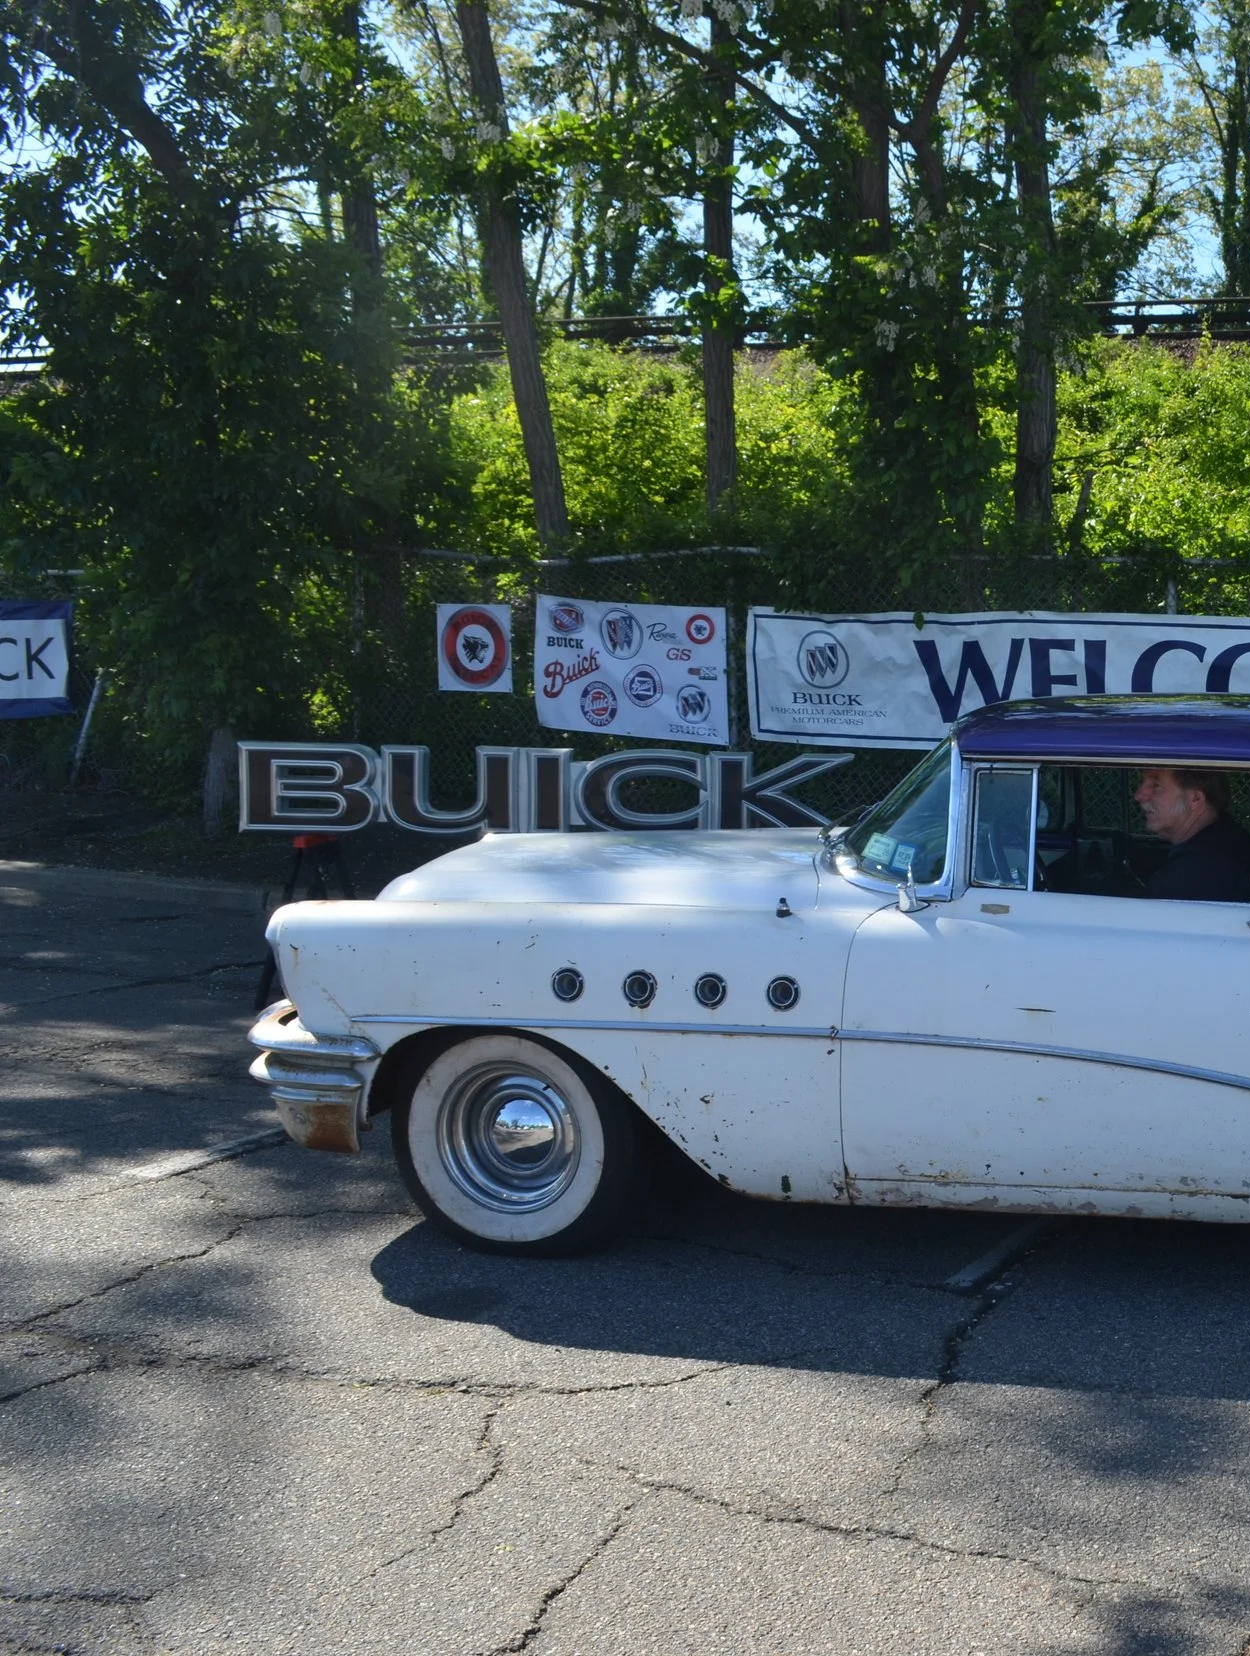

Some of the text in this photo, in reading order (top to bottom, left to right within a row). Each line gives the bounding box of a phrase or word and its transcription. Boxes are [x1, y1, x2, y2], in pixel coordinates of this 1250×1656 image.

[546, 636, 584, 650] BUICK
[666, 647, 692, 662] GS
[543, 647, 601, 699] Buick
[792, 691, 863, 706] BUICK
[770, 705, 888, 719] PREMIUM AMERICAN
[792, 716, 864, 726] MOTORCARS
[669, 723, 719, 738] BUICK
[238, 742, 856, 834] BUICK
